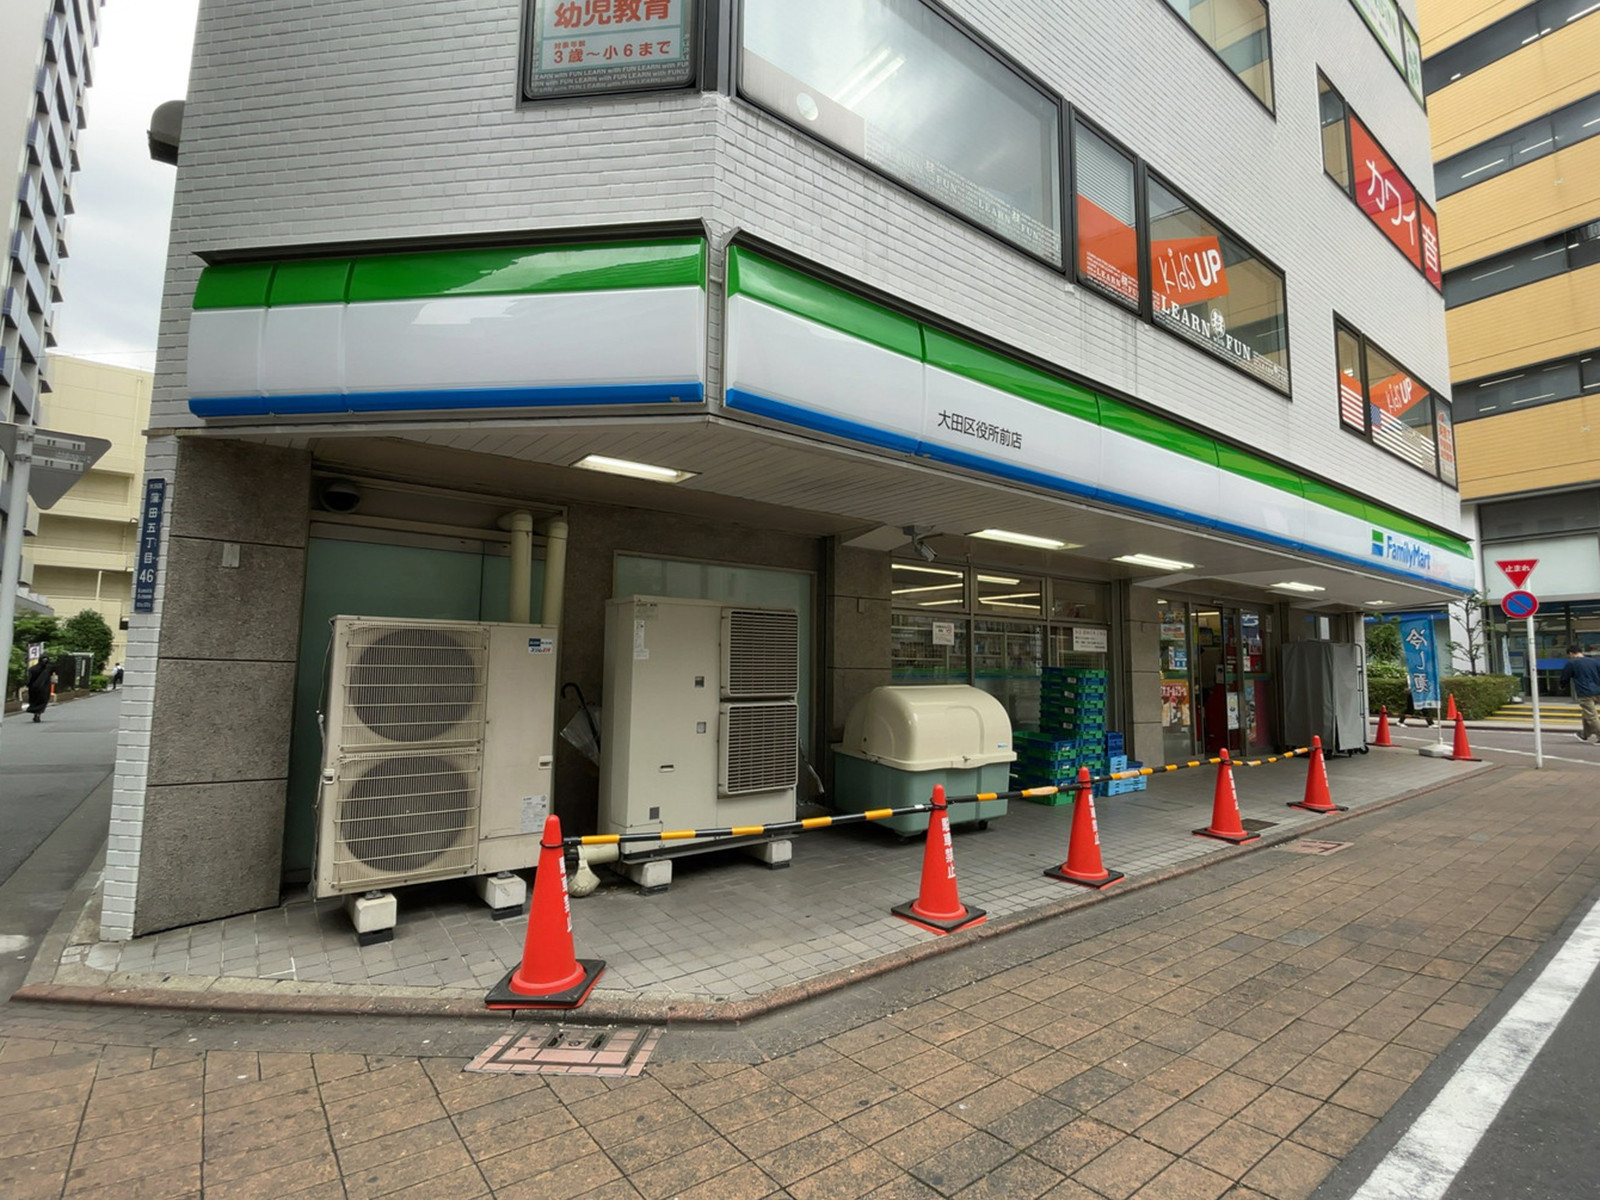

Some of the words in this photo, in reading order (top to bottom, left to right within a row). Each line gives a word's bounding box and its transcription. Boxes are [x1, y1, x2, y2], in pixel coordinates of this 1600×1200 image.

[554, 0, 671, 28] 幼児教育
[978, 200, 1011, 223] LEARN
[1096, 268, 1121, 287] LEARN
[1194, 249, 1222, 286] UP
[1160, 294, 1211, 338] LEARN
[1225, 334, 1251, 360] FUN
[1400, 377, 1412, 404] UP
[938, 410, 1022, 450] 大田区役所前店
[1386, 535, 1431, 570] FamilyMart
[139, 569, 154, 583] 46
[1505, 564, 1531, 573] 止まれ
